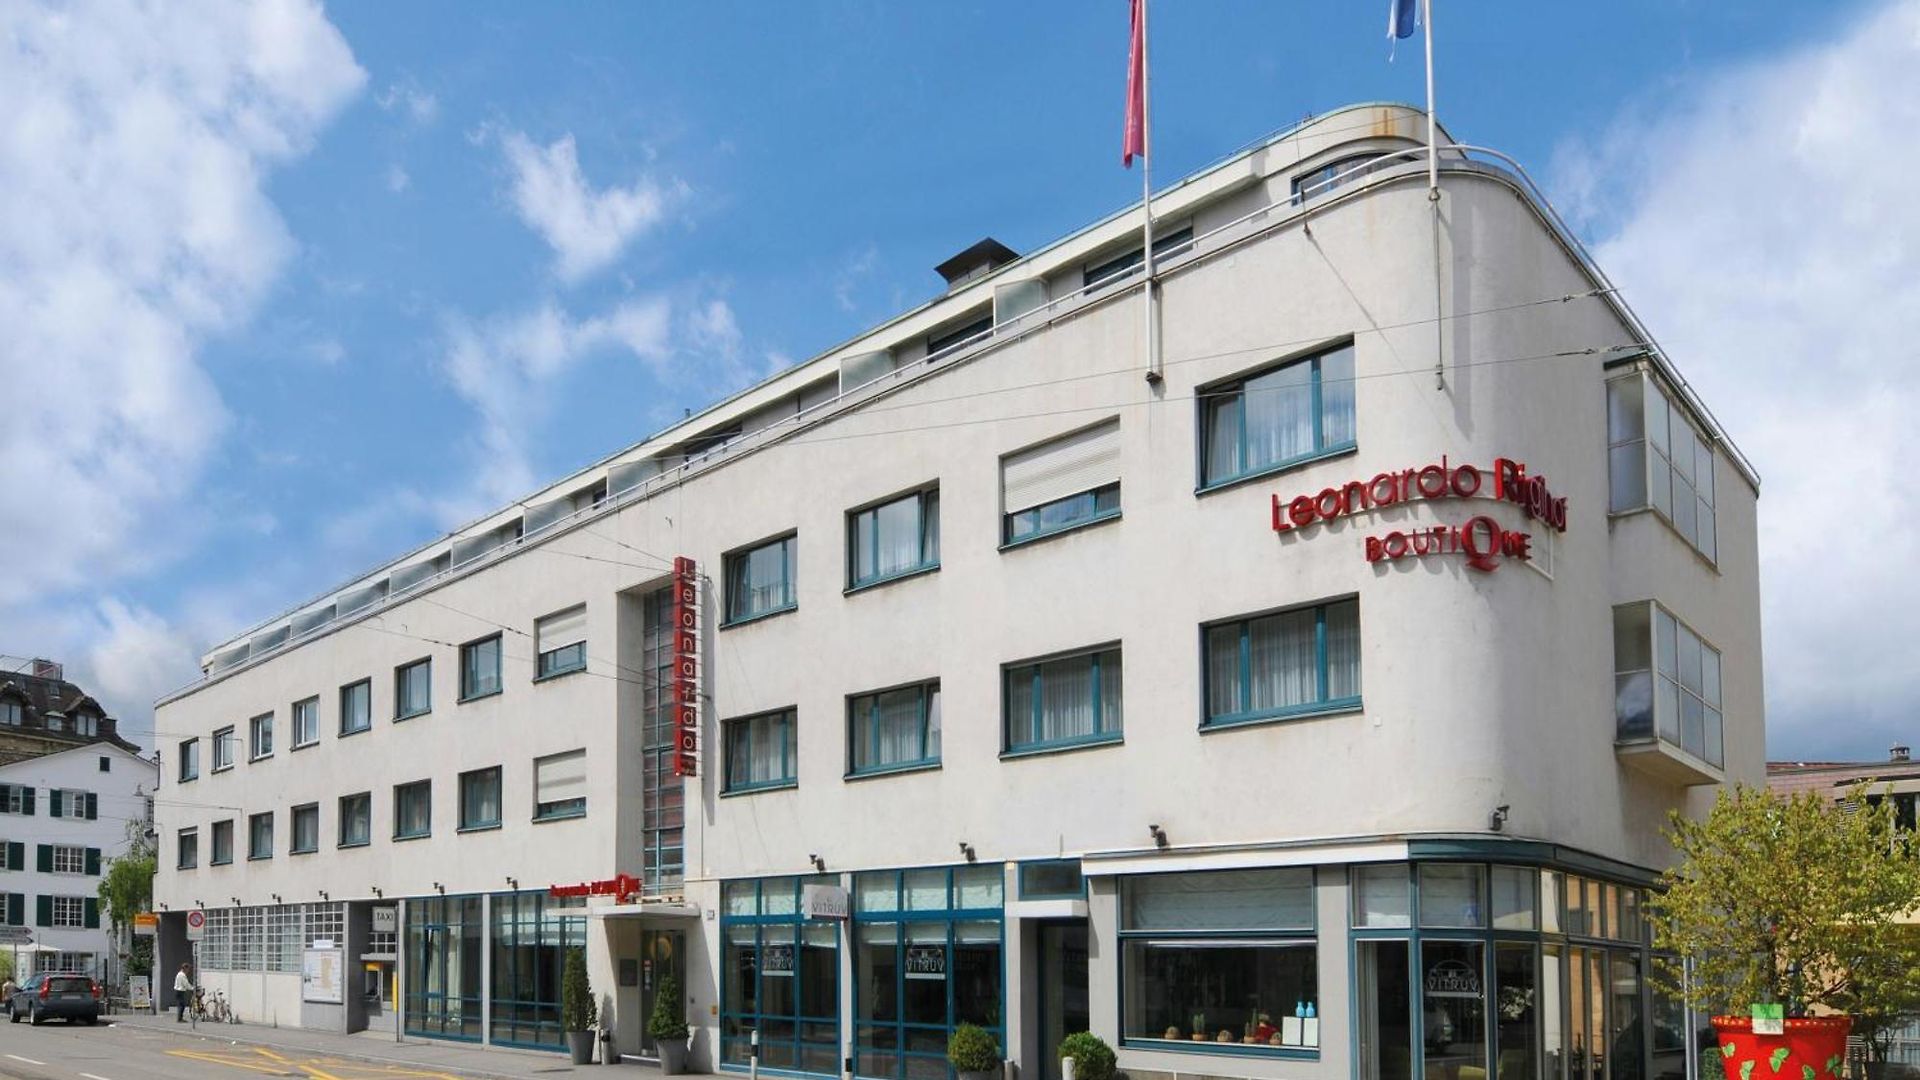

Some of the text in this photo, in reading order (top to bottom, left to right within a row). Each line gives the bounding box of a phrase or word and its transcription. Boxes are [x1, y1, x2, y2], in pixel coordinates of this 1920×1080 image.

[1271, 454, 1481, 531] Leonardo
[1365, 515, 1531, 571] BOUTIQUE
[680, 558, 697, 754] Leonardo
[376, 911, 394, 921] TAXI
